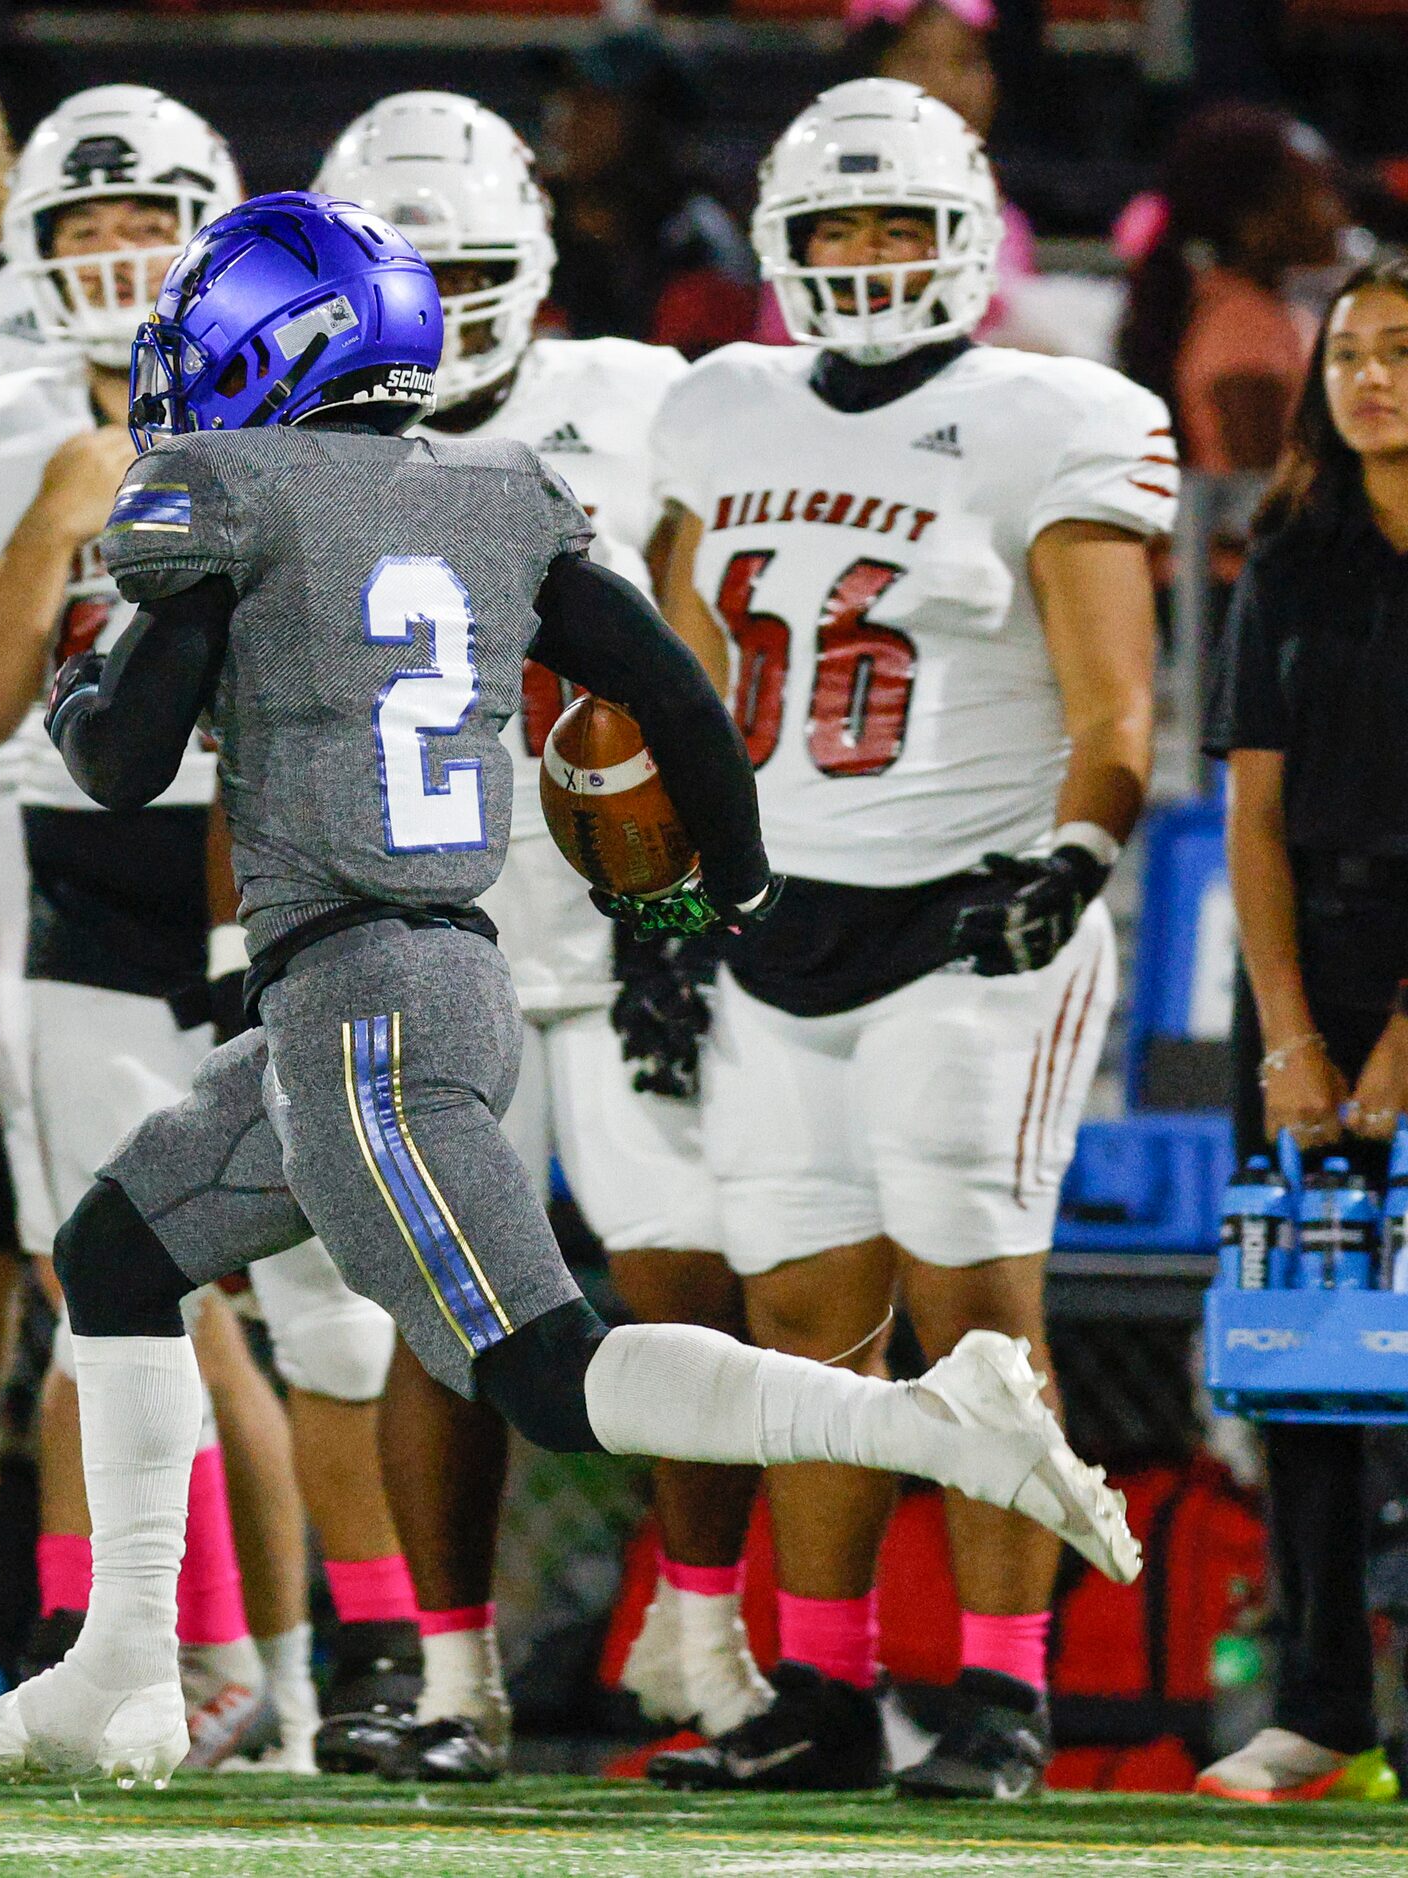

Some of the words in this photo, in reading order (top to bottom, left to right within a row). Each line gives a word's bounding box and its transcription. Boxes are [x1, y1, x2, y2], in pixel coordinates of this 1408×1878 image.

[712, 488, 938, 542] HILLCREST
[360, 555, 487, 855] 2
[714, 549, 918, 778] 66
